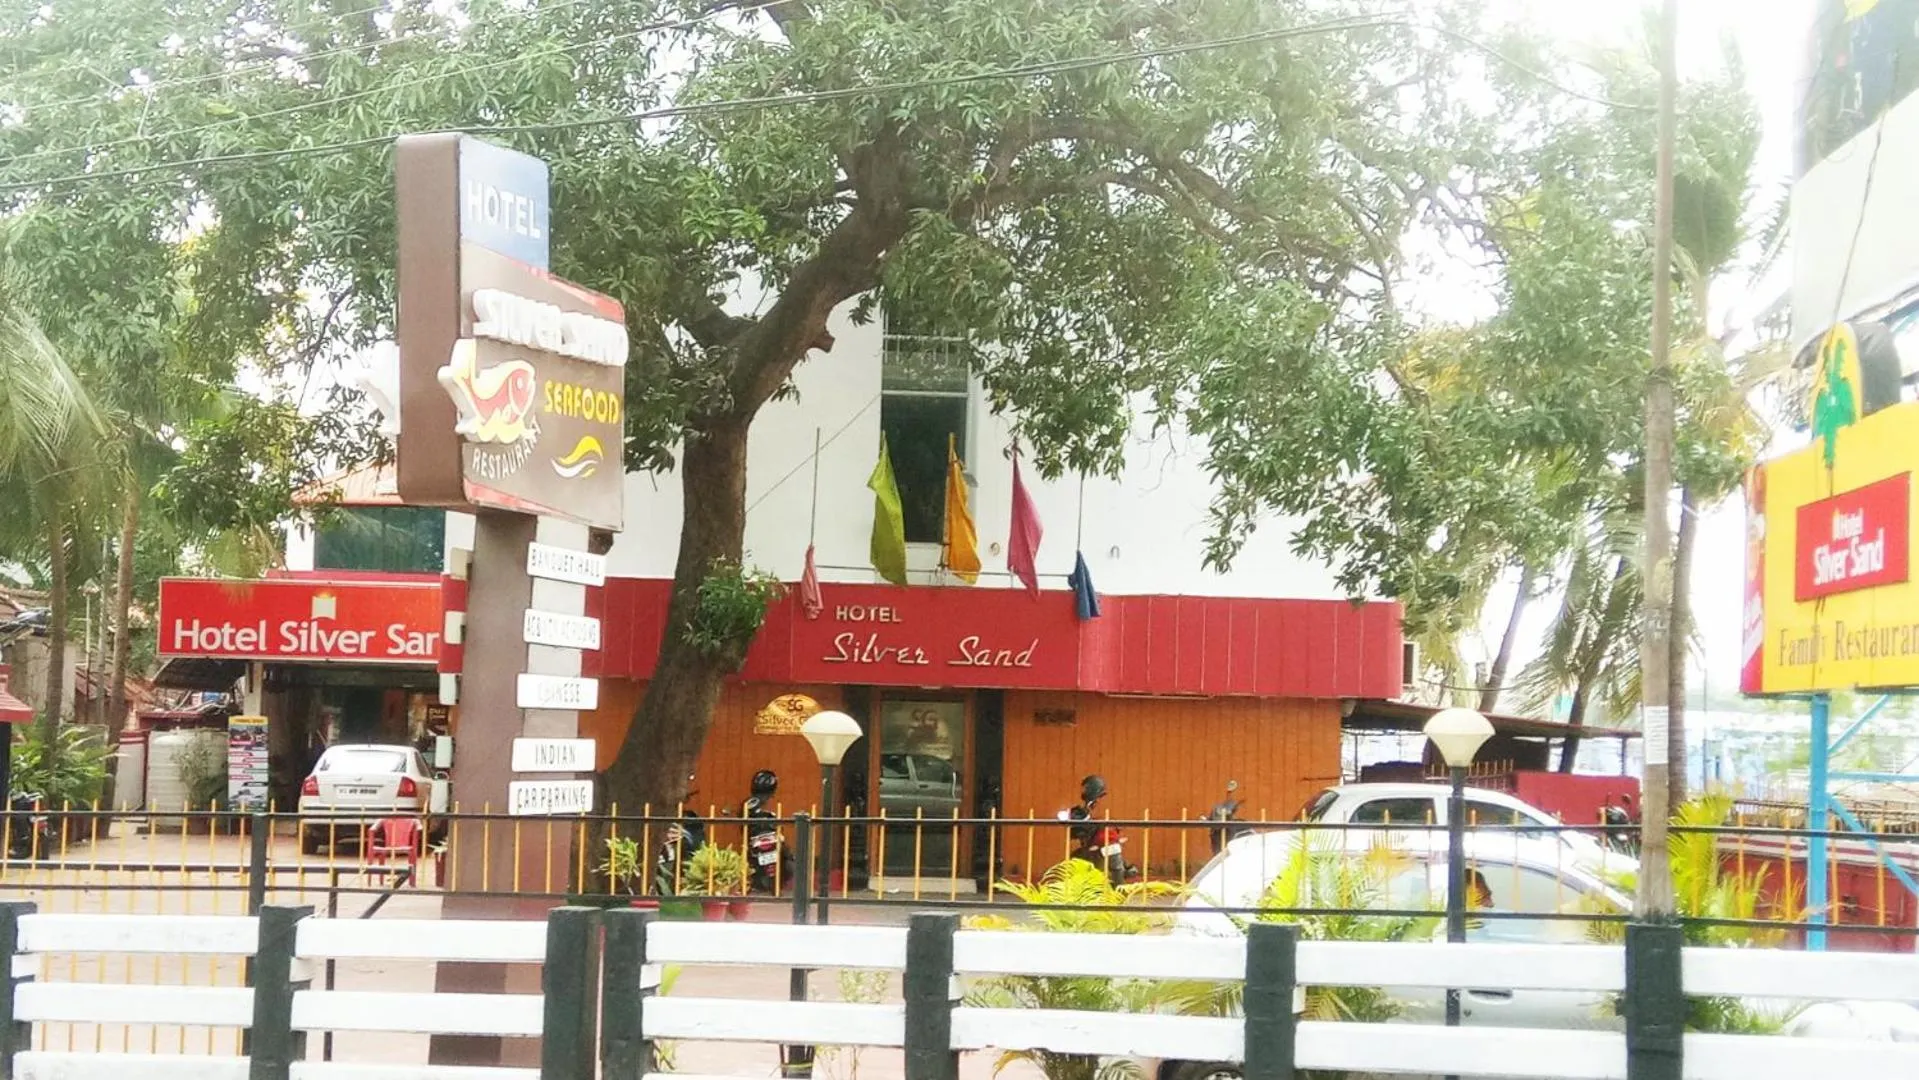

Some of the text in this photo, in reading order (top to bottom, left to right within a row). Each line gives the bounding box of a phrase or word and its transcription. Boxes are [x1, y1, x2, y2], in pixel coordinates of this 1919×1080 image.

[467, 179, 541, 239] HOTEL
[544, 380, 619, 425] SEAFOOD
[1813, 527, 1885, 586] Silver Sand
[835, 604, 902, 623] HOTEL
[174, 618, 267, 651] Hotel
[279, 620, 376, 654] Silver
[823, 631, 1040, 667] Silver Sand
[534, 743, 577, 767] INDIAN
[517, 785, 587, 810] CAR PARKING
